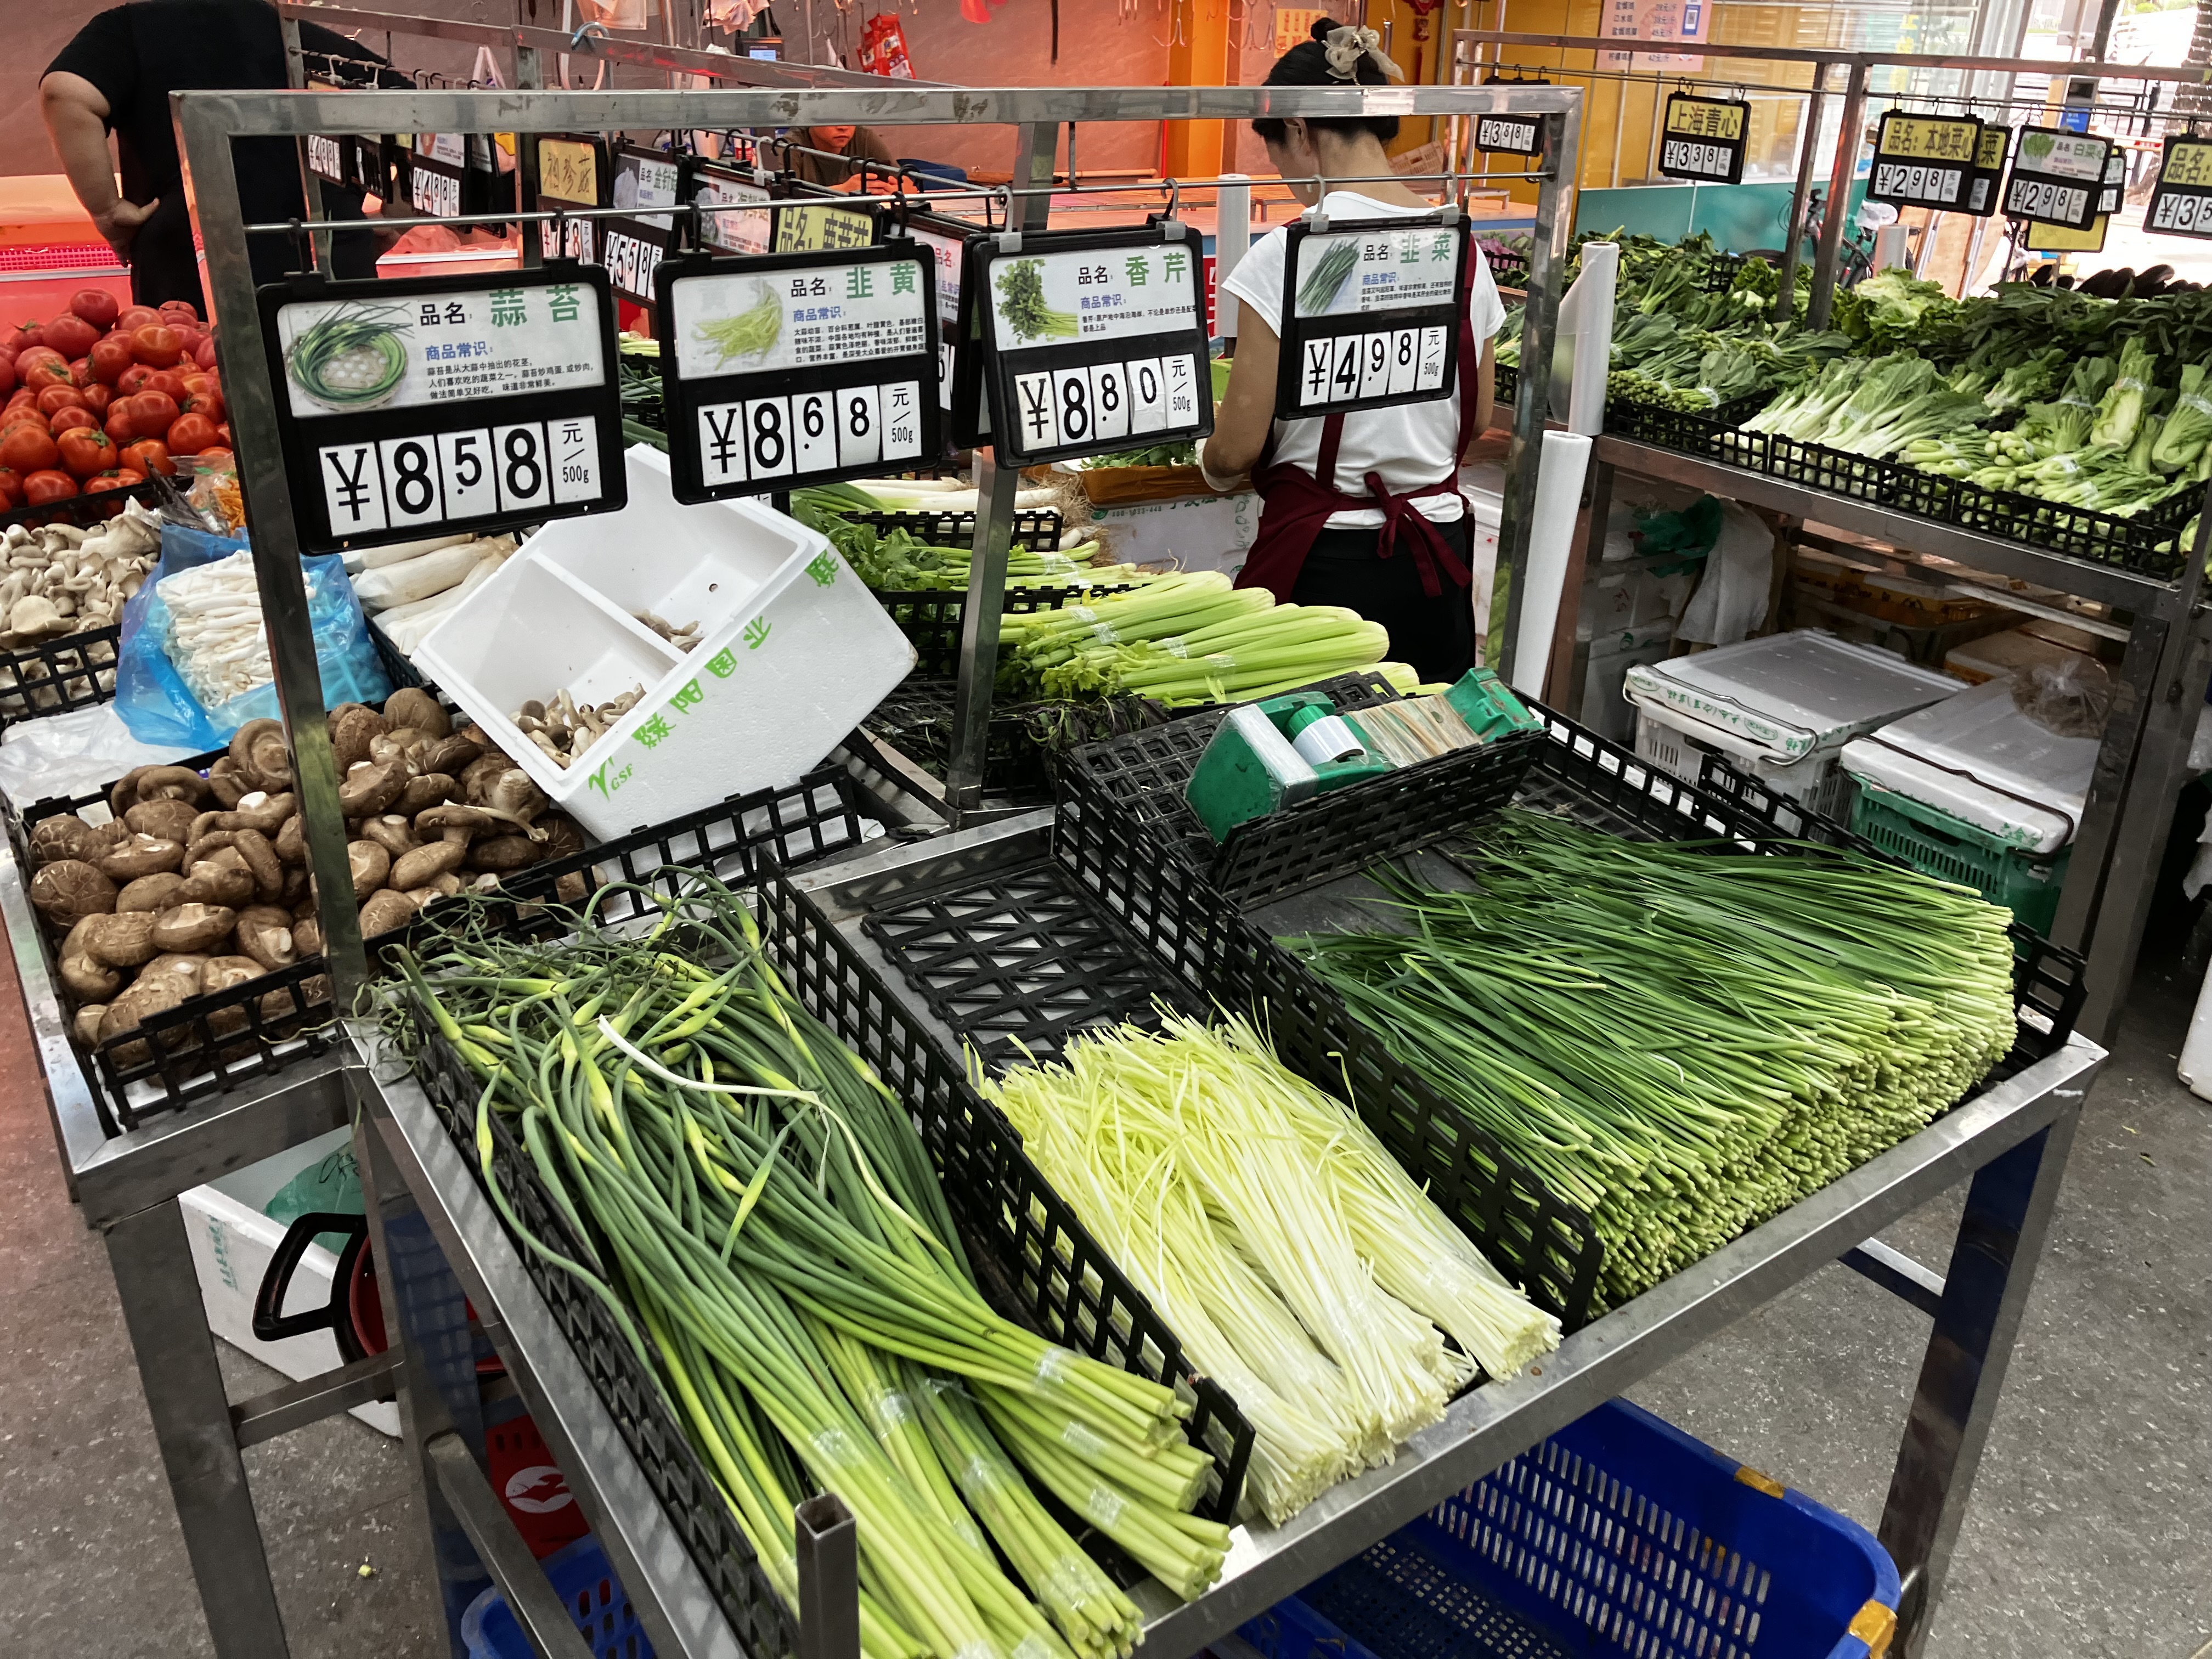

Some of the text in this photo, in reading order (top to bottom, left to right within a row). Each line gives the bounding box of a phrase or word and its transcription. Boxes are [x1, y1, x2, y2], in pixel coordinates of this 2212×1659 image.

[1671, 103, 1738, 137] 上海青心
[1401, 232, 1451, 263] 韭菜
[847, 263, 916, 300] 韭黄
[1125, 252, 1186, 286] 香芹
[420, 284, 581, 328] 品名： 蒜苔
[426, 341, 493, 361] 商品常识：
[1308, 332, 1411, 396] ¥4.98
[1020, 367, 1157, 439] ¥8.80
[704, 397, 870, 473] ¥8.68
[325, 428, 542, 522] ¥8.58
[610, 764, 633, 790] GSF
